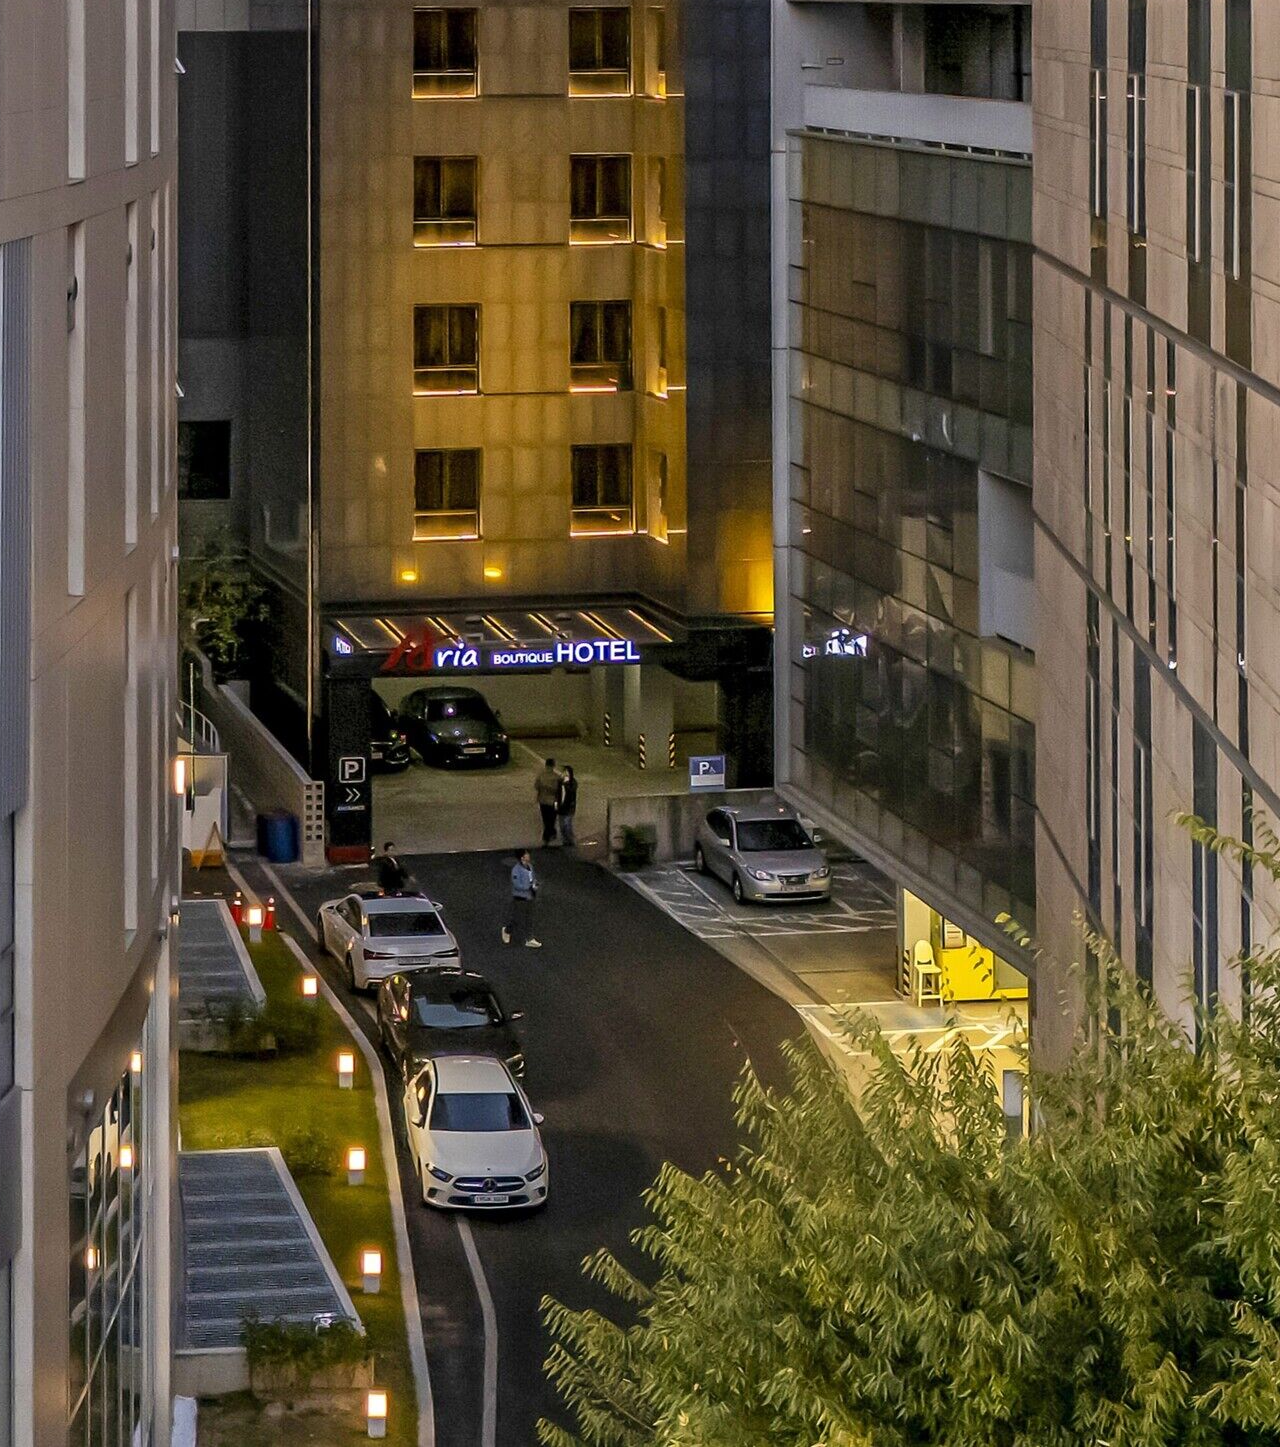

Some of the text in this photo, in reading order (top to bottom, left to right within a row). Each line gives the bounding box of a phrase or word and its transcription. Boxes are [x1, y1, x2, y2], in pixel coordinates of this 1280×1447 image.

[381, 625, 641, 671] Aria BOUTIQUE HOTEL
